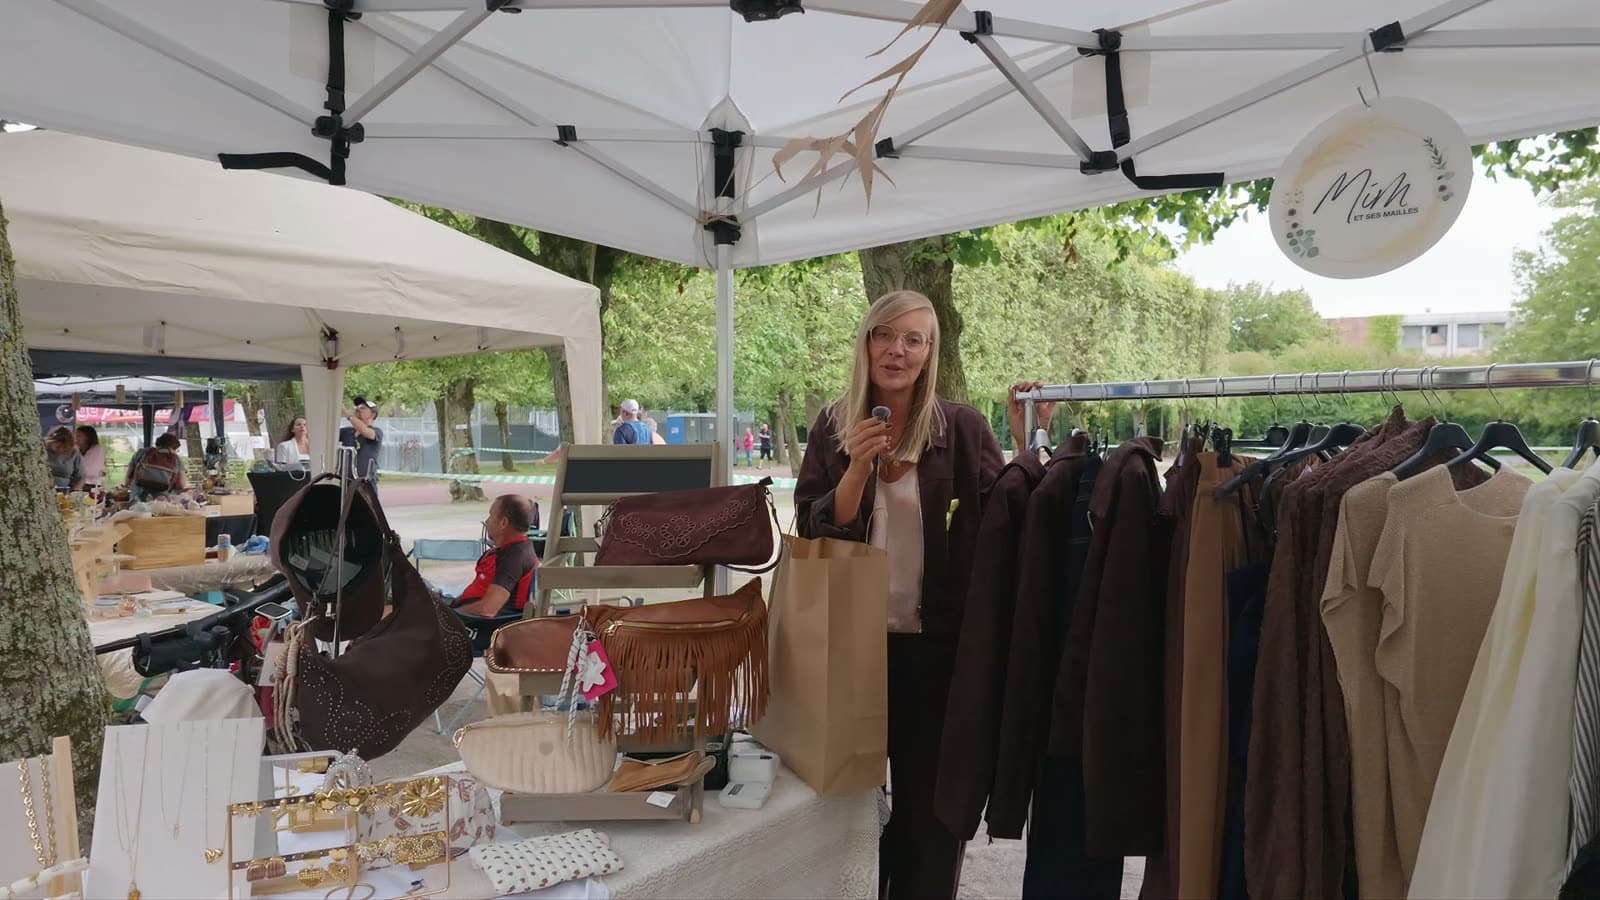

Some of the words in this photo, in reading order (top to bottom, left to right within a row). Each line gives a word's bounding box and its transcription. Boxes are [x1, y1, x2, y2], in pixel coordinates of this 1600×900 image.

[1353, 214, 1364, 222] ET
[1365, 212, 1381, 220] SES
[1382, 207, 1420, 218] MAILLES
